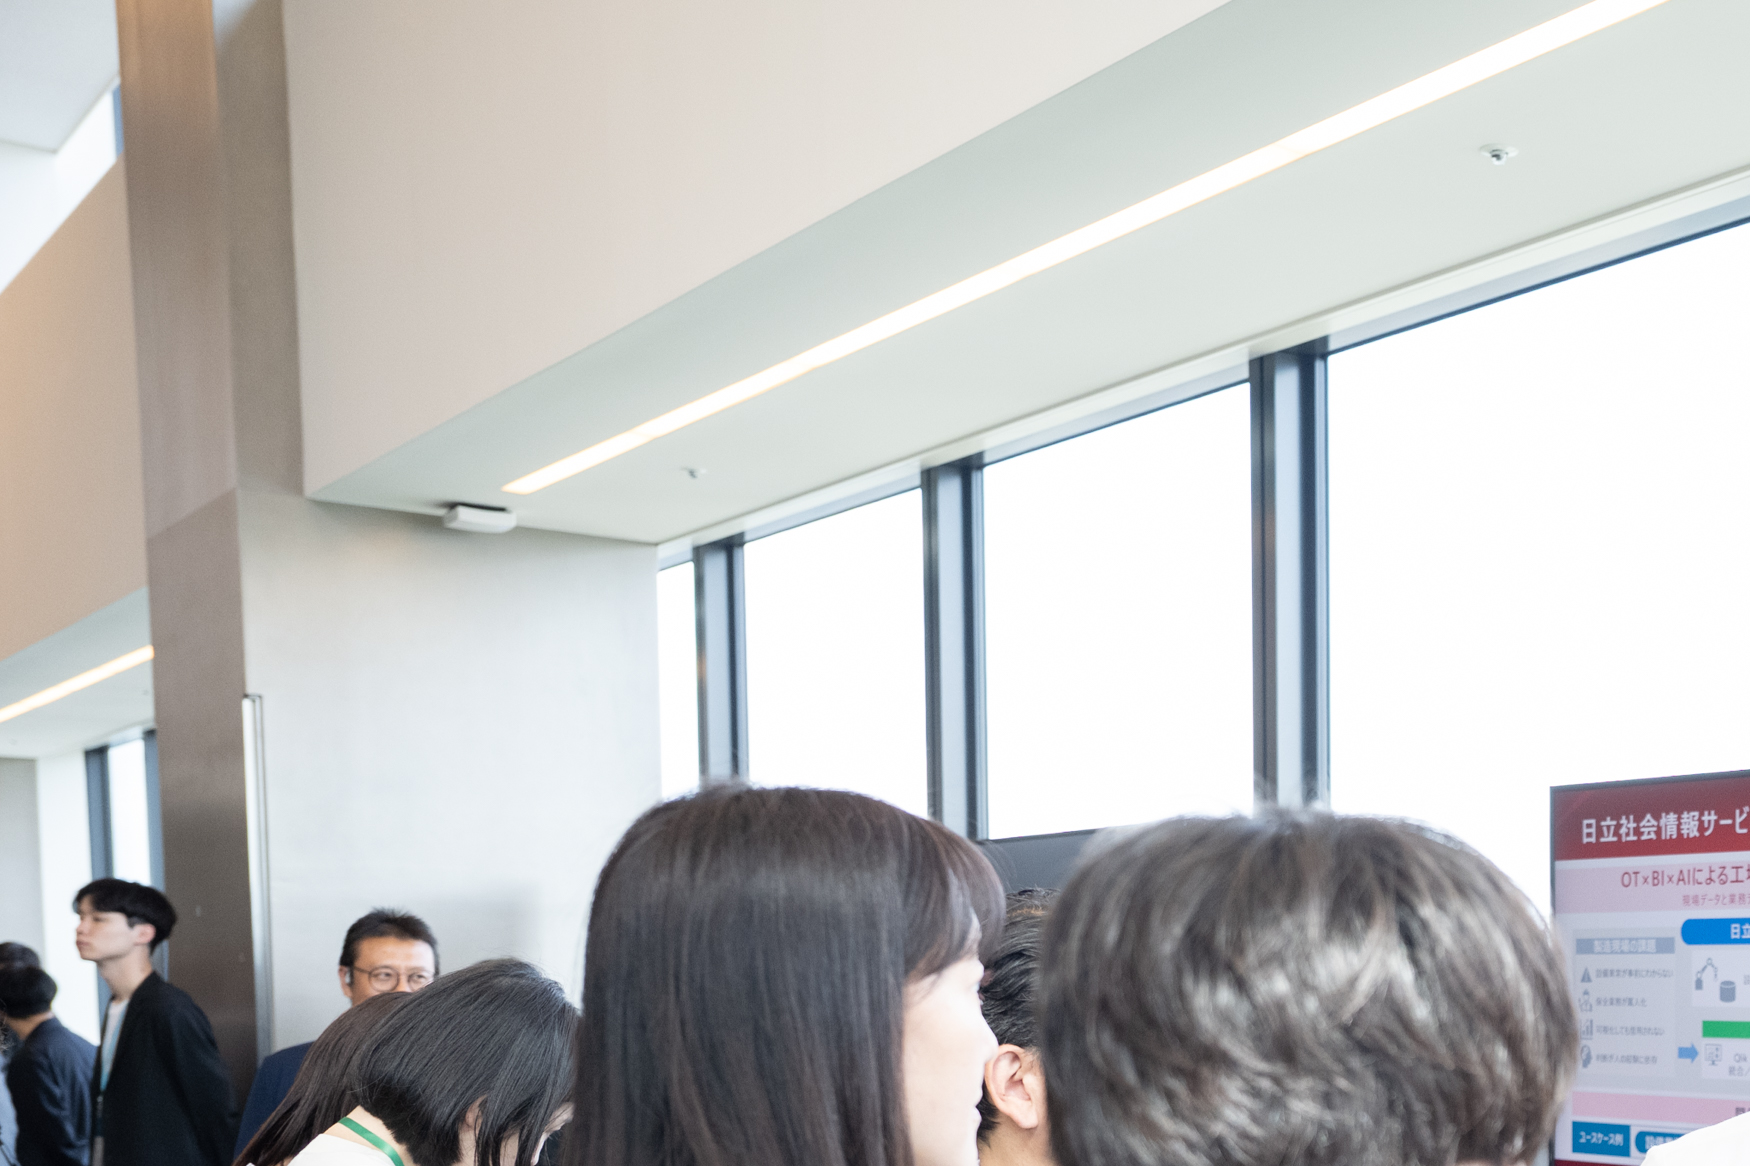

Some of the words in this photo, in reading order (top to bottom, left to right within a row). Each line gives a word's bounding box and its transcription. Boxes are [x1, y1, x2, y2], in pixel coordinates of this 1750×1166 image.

[1578, 1131, 1624, 1147] ユースケース例
